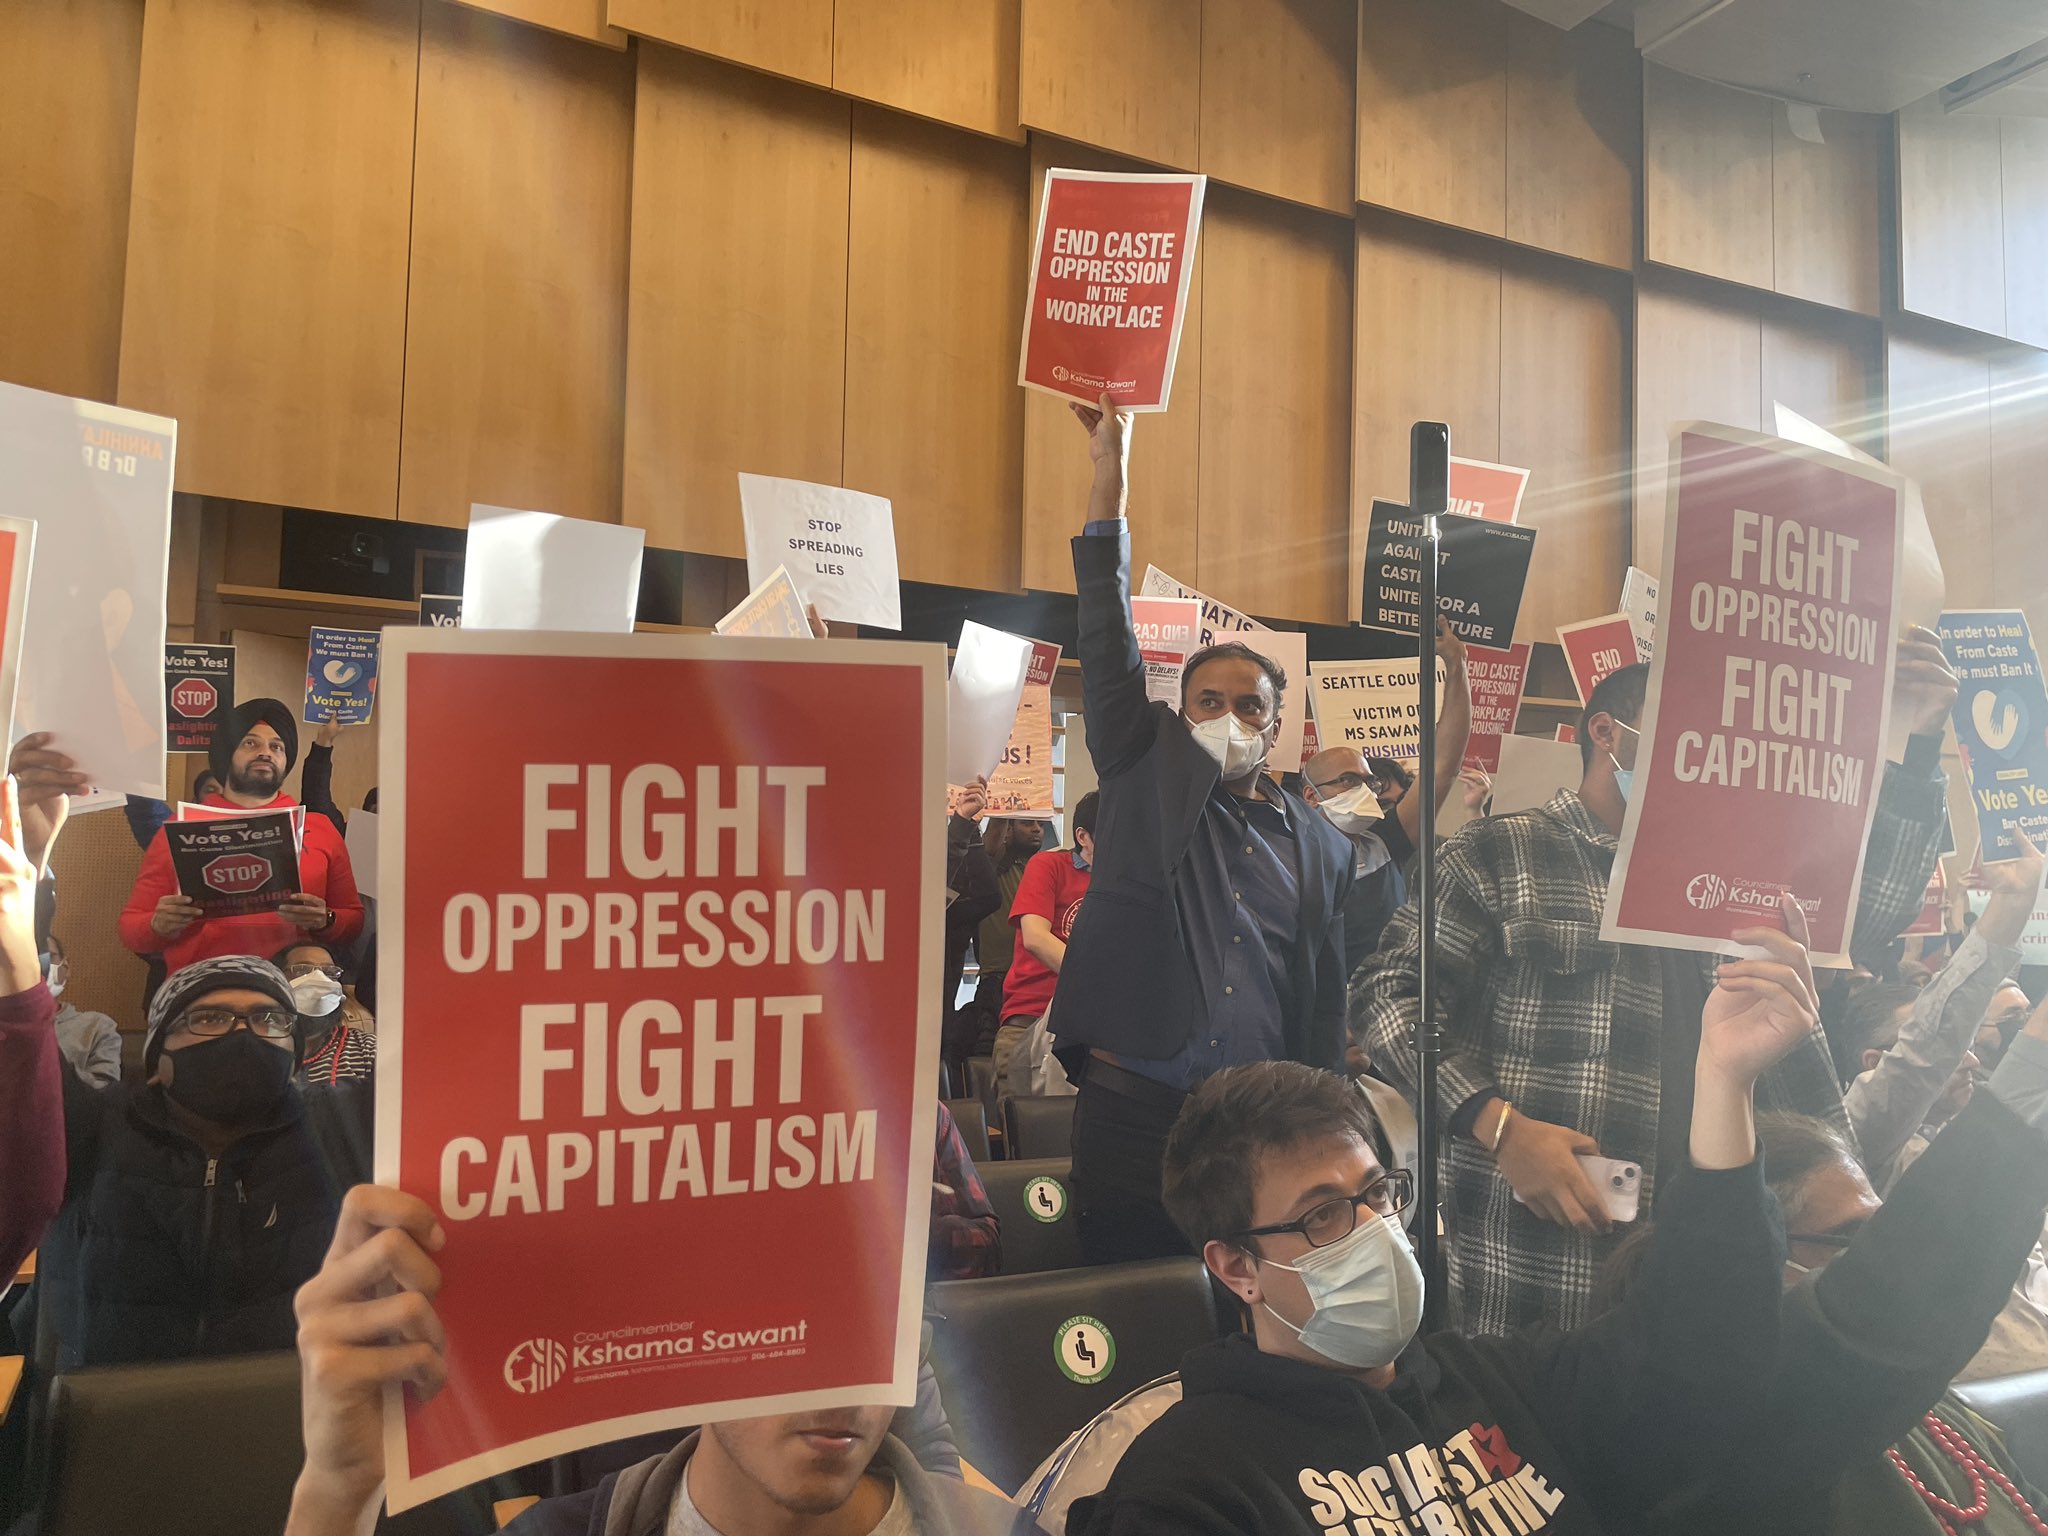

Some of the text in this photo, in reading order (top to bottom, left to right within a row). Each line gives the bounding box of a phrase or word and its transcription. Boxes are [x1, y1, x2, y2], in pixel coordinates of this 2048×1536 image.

[1053, 228, 1175, 259] END CASTE
[1050, 256, 1170, 284] OPPRESSION
[1086, 285, 1128, 303] IN THE
[1046, 298, 1163, 328] WORKPLACE
[1070, 373, 1104, 388] Kshama
[1106, 380, 1136, 389] Sawant
[808, 519, 842, 533] STOP
[1388, 519, 1443, 540] UNITD
[788, 538, 863, 558] SPREADING
[1383, 542, 1450, 566] AGAIT
[1731, 509, 1860, 605] FIGHT
[815, 562, 845, 576] LIES
[1379, 586, 1421, 605] UNITE
[1467, 602, 1480, 616] A
[430, 613, 462, 627] Vot
[1379, 608, 1420, 627] BETTE
[1689, 581, 1878, 666] OPPRESSION
[326, 634, 346, 642] order
[1940, 623, 2023, 640] In order to Heal
[324, 641, 343, 649] From
[1956, 644, 2018, 659] From Caste
[165, 656, 228, 668] Vote Yes!
[1591, 648, 1622, 673] END
[1467, 661, 1521, 681] END CASTE
[1971, 664, 1999, 679] must
[2000, 662, 2022, 677] Ban
[2024, 662, 2033, 675] It
[1322, 675, 1384, 690] SEATTLE
[1470, 678, 1517, 696] PPRESSION
[178, 691, 211, 706] STOP
[312, 694, 367, 707] Vote Yes!
[1479, 695, 1498, 705] IN THE
[1720, 655, 1852, 746] FIGHT
[1353, 704, 1402, 720] VICTIM
[1471, 706, 1511, 722] RKPLACE
[1345, 724, 1420, 740] MS SAWAN
[1362, 743, 1420, 758] RUSHIN
[1674, 730, 1864, 807] CAPITALISM
[1978, 787, 2018, 811] Vote
[522, 763, 827, 880] FIGHT
[2002, 817, 2017, 830] Ban
[179, 834, 231, 845] Vote
[238, 826, 280, 841] Yes!
[212, 864, 263, 883] STOP
[443, 888, 887, 973] OPPRESSION
[519, 994, 823, 1121] FIGHT
[439, 1110, 879, 1222] CAPITALISM
[573, 1320, 695, 1344] Councilmember
[1058, 1316, 1081, 1336] PLEASE
[1094, 1319, 1110, 1337] HERE
[573, 1320, 808, 1368] Kshama Sawant
[1073, 1375, 1090, 1384] Thank
